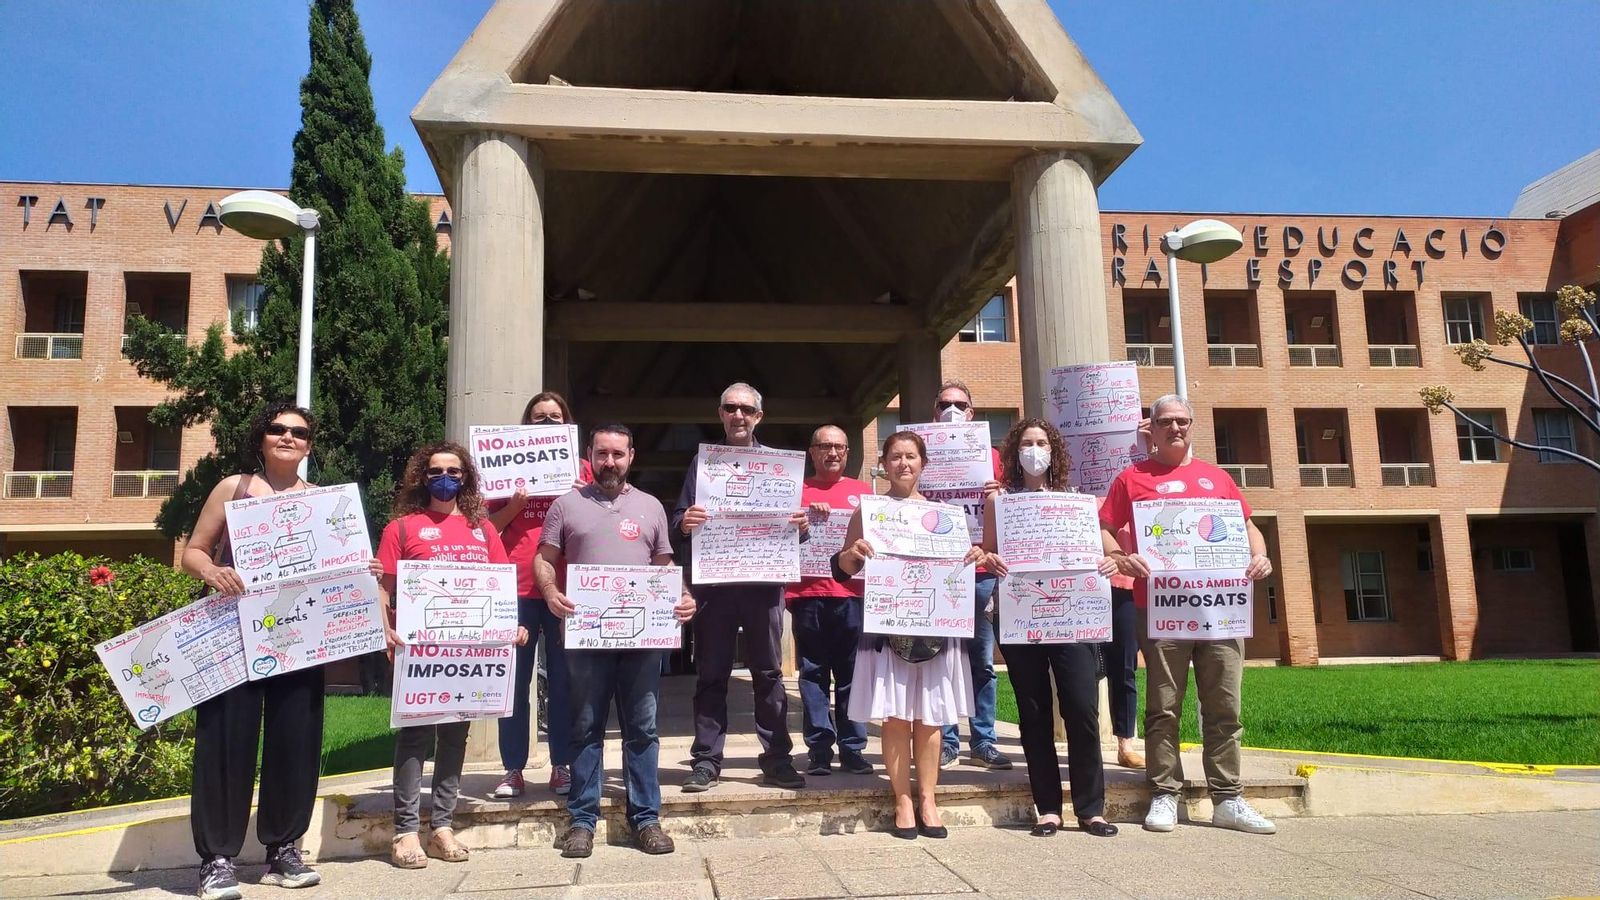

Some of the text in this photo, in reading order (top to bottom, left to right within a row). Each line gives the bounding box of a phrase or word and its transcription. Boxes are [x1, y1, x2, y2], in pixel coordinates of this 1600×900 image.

[1247, 257, 1427, 290] ESPORT
[477, 434, 568, 452] NO ALS ÀMBITS
[480, 447, 570, 469] IMPOSATS
[748, 461, 769, 472] UGT
[485, 478, 513, 492] UGT
[935, 491, 953, 499] ALS
[234, 525, 253, 538] UGT
[1144, 518, 1192, 539] Docents
[451, 544, 464, 552] un
[454, 577, 478, 588] UGT
[580, 575, 611, 589] UGT
[1050, 578, 1077, 589] UGT
[1154, 576, 1249, 590] NO ALS ÀMBITS
[320, 586, 342, 596] ACORD
[325, 591, 344, 604] UGT
[1154, 592, 1248, 608] IMPOSATS
[1155, 619, 1186, 632] UGT
[1027, 629, 1043, 640] NO
[409, 643, 510, 658] NO ALS ÀMBITS
[407, 663, 507, 679] IMPOSATS
[404, 692, 437, 705] UGT
